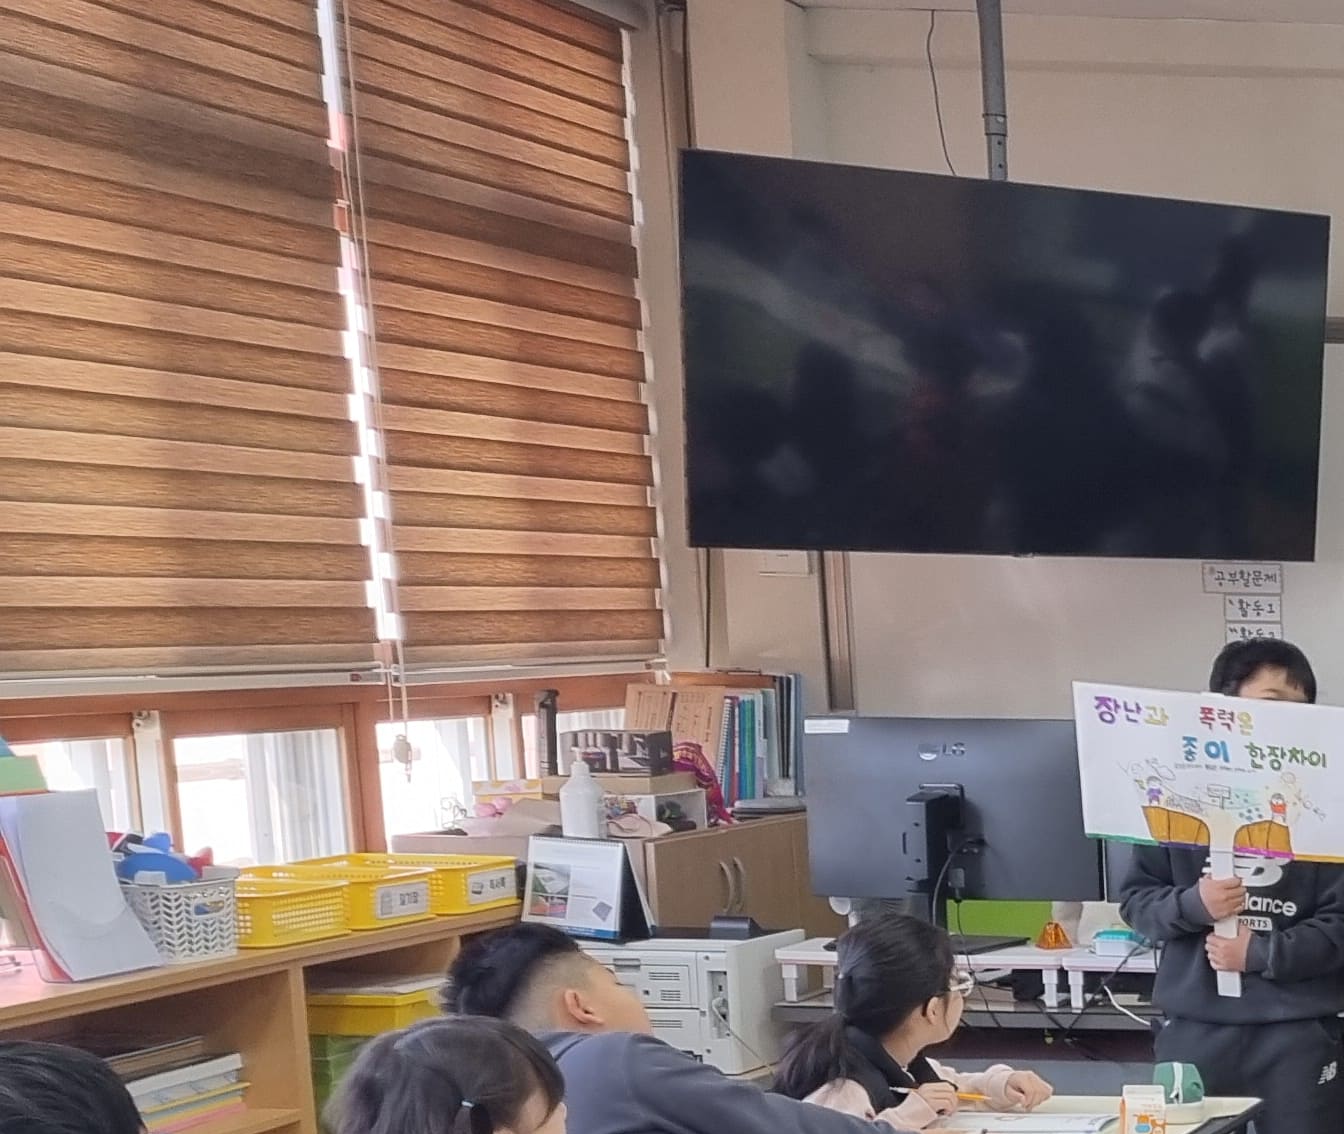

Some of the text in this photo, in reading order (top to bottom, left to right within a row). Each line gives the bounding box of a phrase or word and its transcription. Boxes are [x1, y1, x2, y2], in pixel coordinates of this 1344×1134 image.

[1094, 695, 1170, 727] 장난과
[1182, 735, 1231, 763] 종이
[1245, 892, 1297, 916] lance
